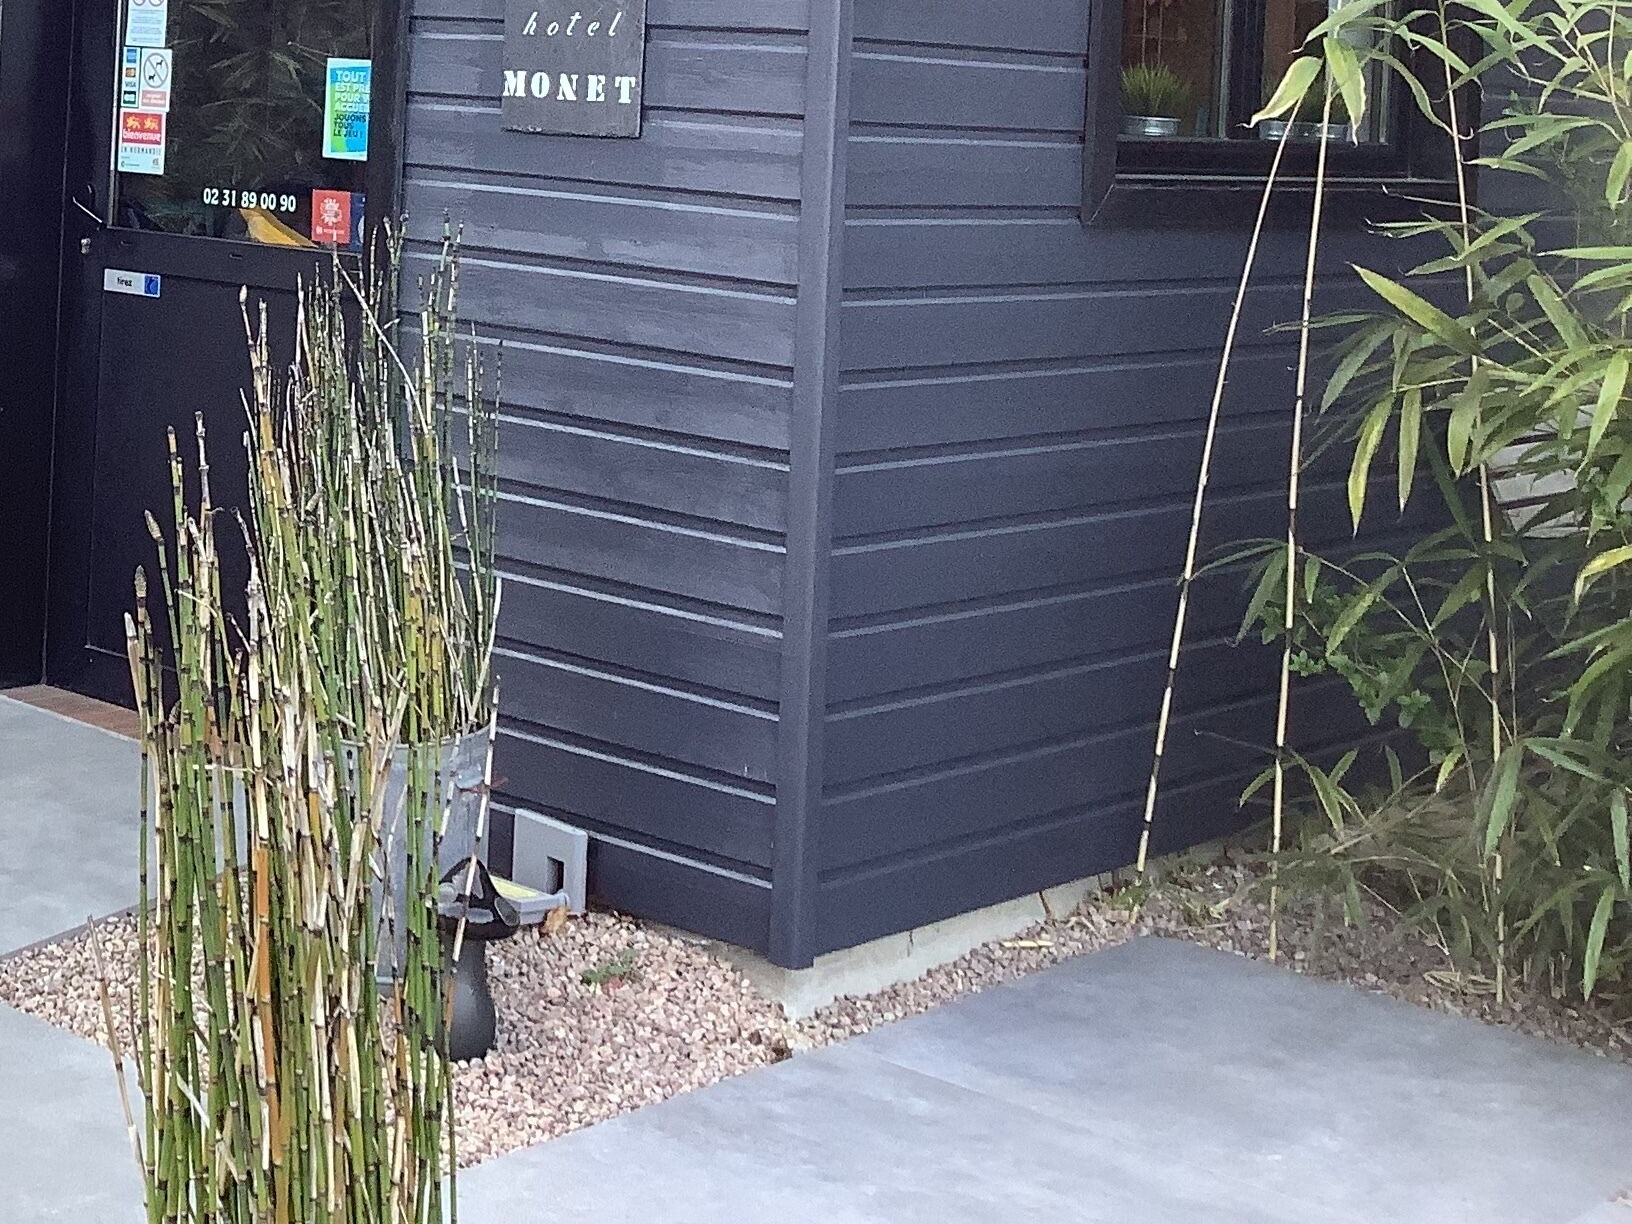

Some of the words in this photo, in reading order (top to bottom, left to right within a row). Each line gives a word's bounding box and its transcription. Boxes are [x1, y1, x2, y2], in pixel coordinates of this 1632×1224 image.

[522, 11, 622, 37] hotel
[335, 70, 367, 83] TOUT
[335, 82, 351, 93] EST
[502, 70, 637, 105] MONET
[334, 92, 360, 104] POUR
[334, 113, 367, 123] JOUONS
[203, 187, 219, 205] 02
[221, 189, 236, 207] 31
[241, 191, 257, 208] 89
[260, 193, 276, 211] 00
[279, 194, 296, 212] 90
